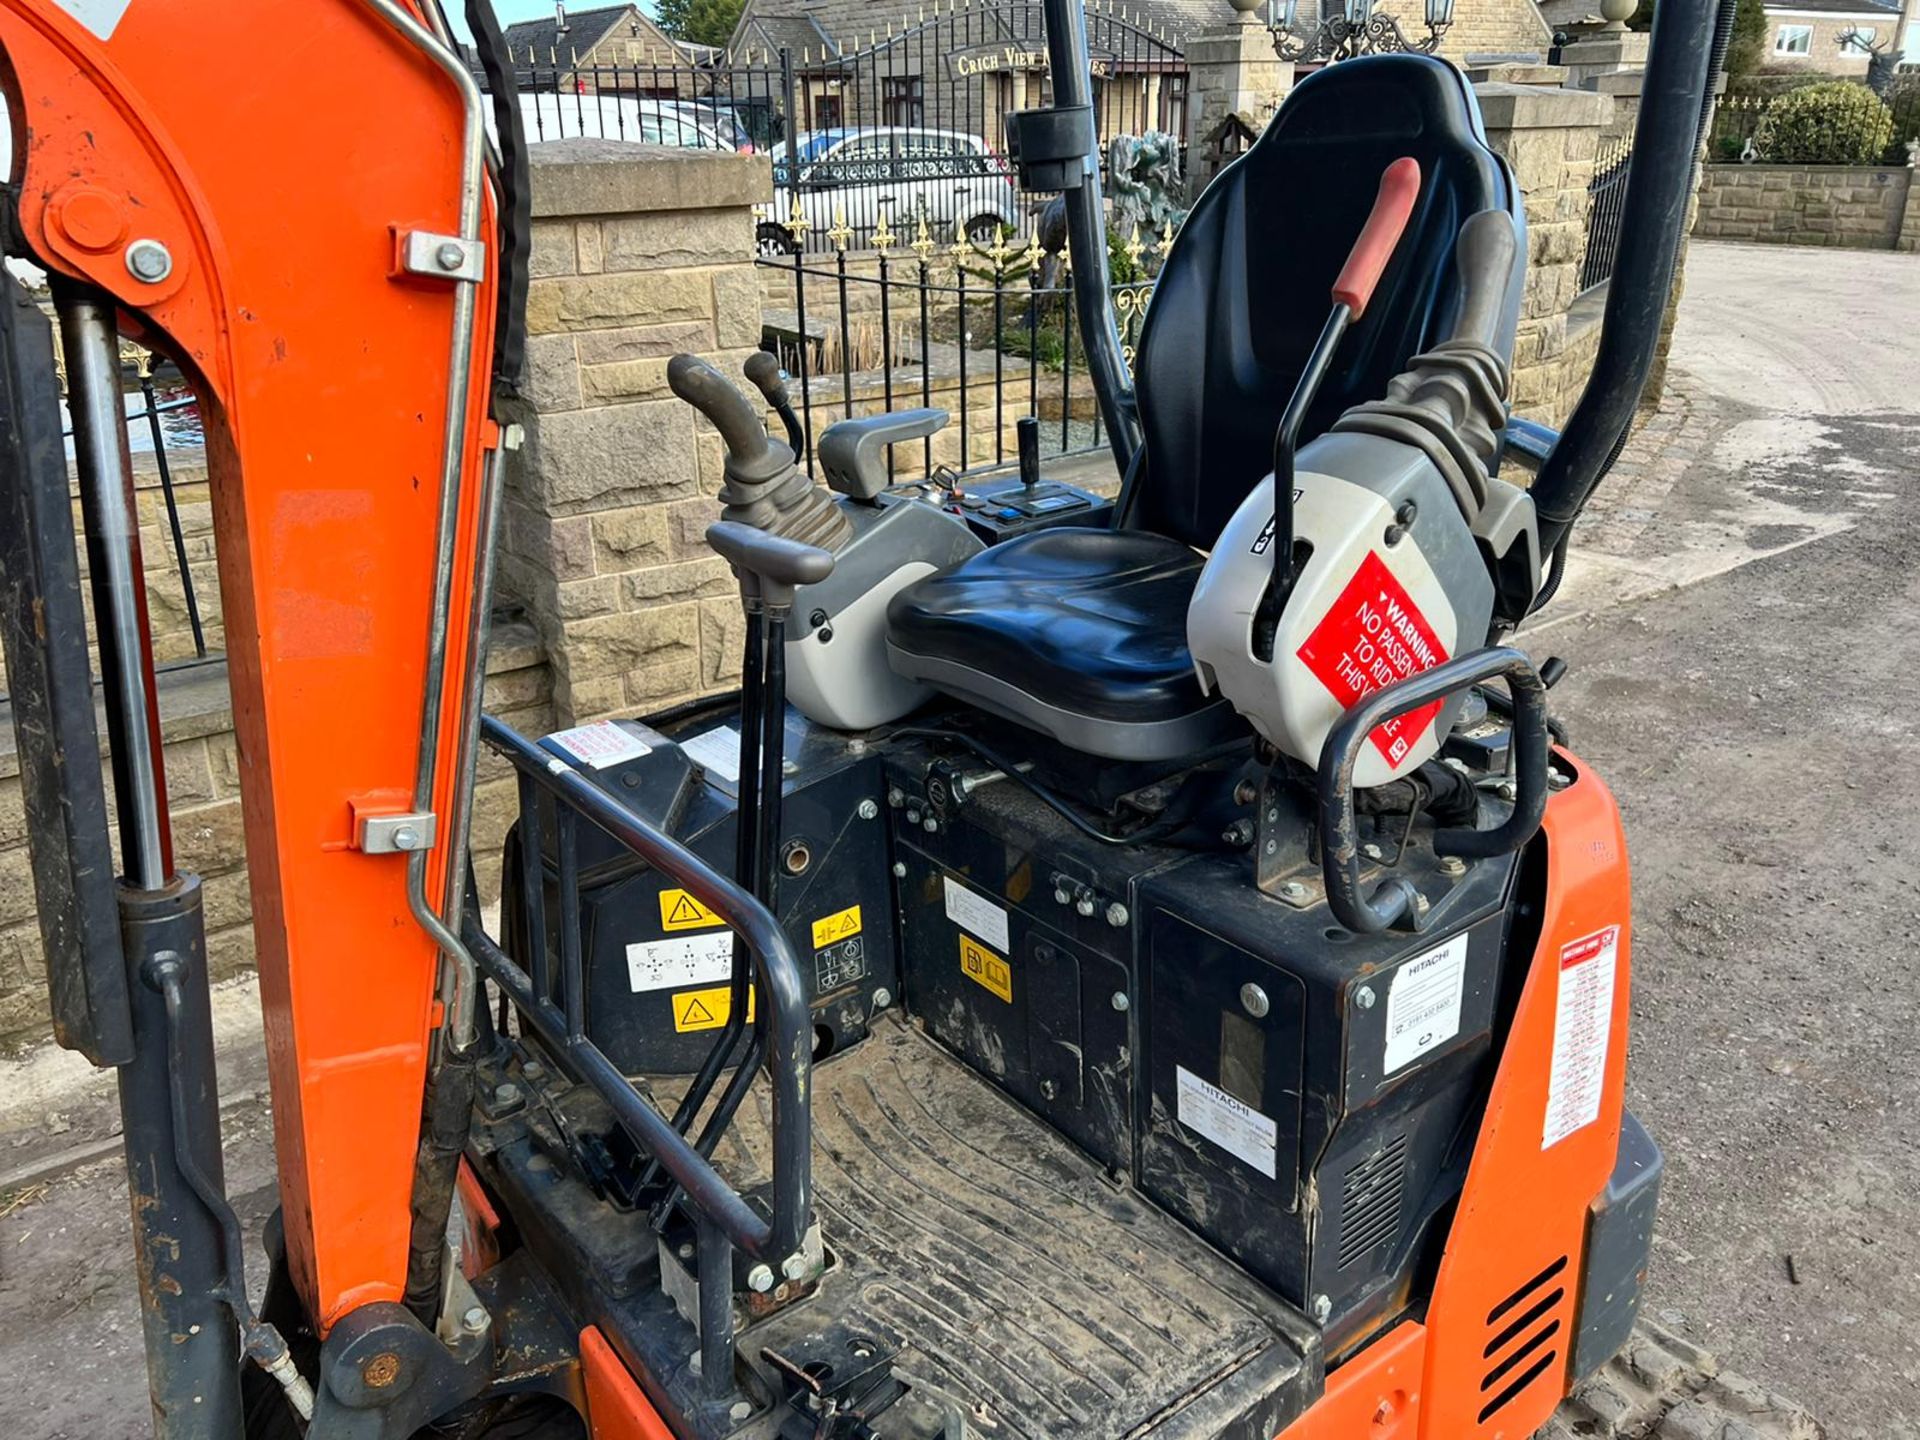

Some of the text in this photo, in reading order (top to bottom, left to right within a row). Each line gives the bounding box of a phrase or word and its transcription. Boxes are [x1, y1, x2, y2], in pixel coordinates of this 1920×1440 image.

[1353, 633, 1375, 663] TO
[1355, 601, 1382, 634] NO
[1376, 627, 1419, 678] PASSEN
[1386, 598, 1437, 670] WARNING
[1335, 652, 1367, 692] THIS
[1408, 948, 1450, 977] HITACHI
[1200, 1082, 1250, 1117] HITACHI
